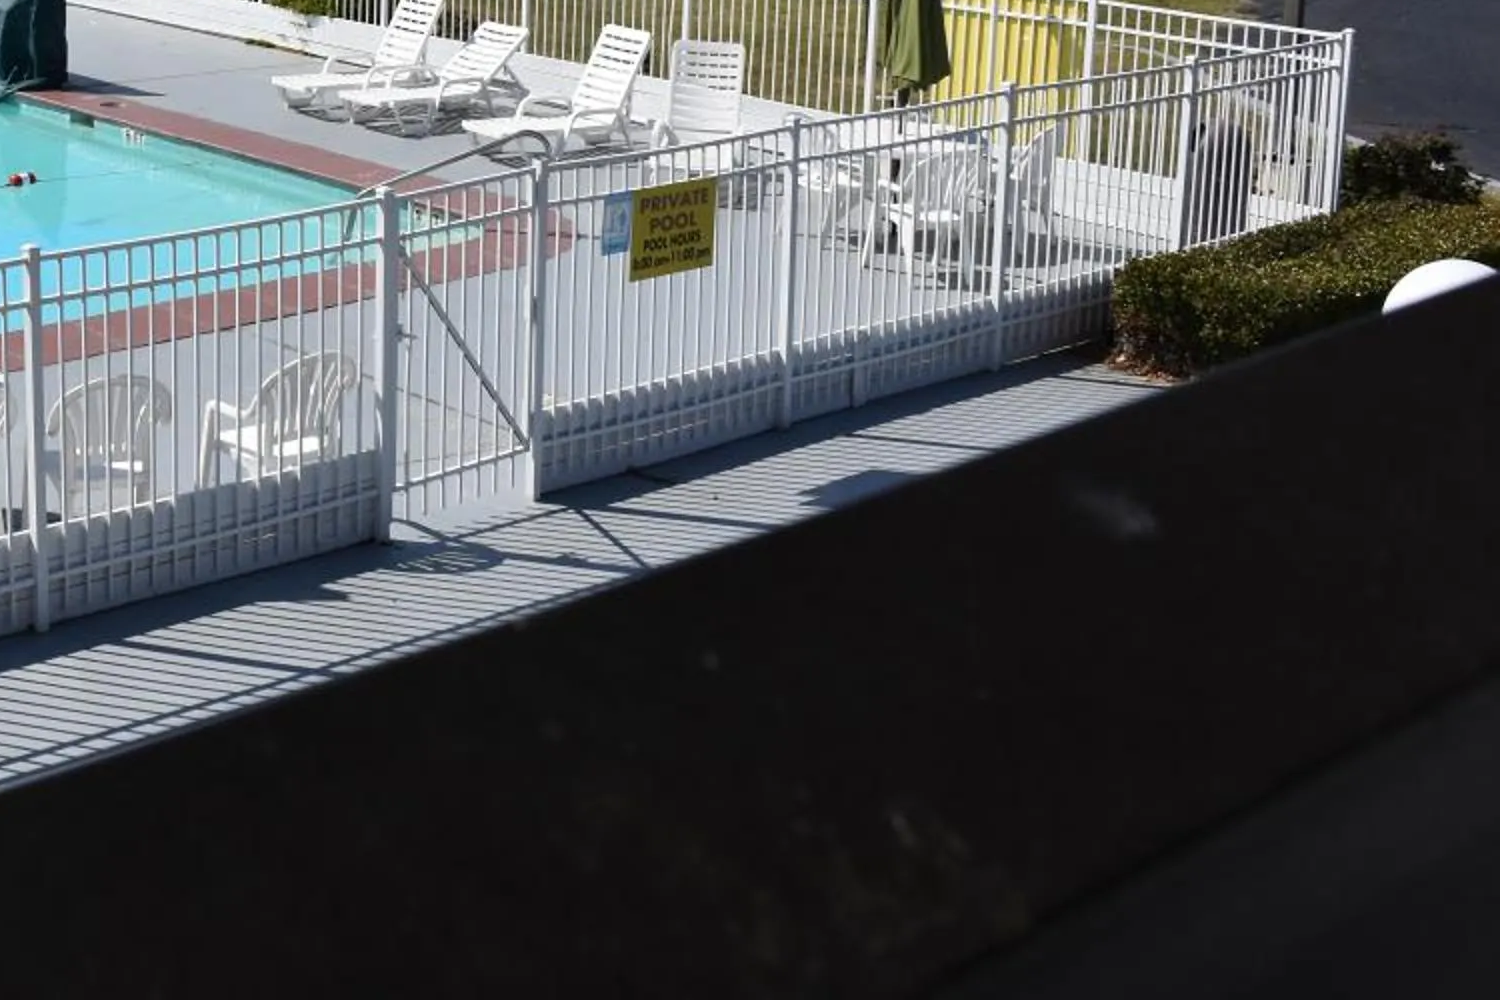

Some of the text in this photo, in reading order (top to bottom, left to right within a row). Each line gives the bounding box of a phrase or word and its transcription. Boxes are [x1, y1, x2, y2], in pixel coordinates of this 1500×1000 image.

[641, 187, 709, 215] PRIVATE
[649, 211, 698, 233] POOL
[643, 229, 702, 253] POOL HOURS
